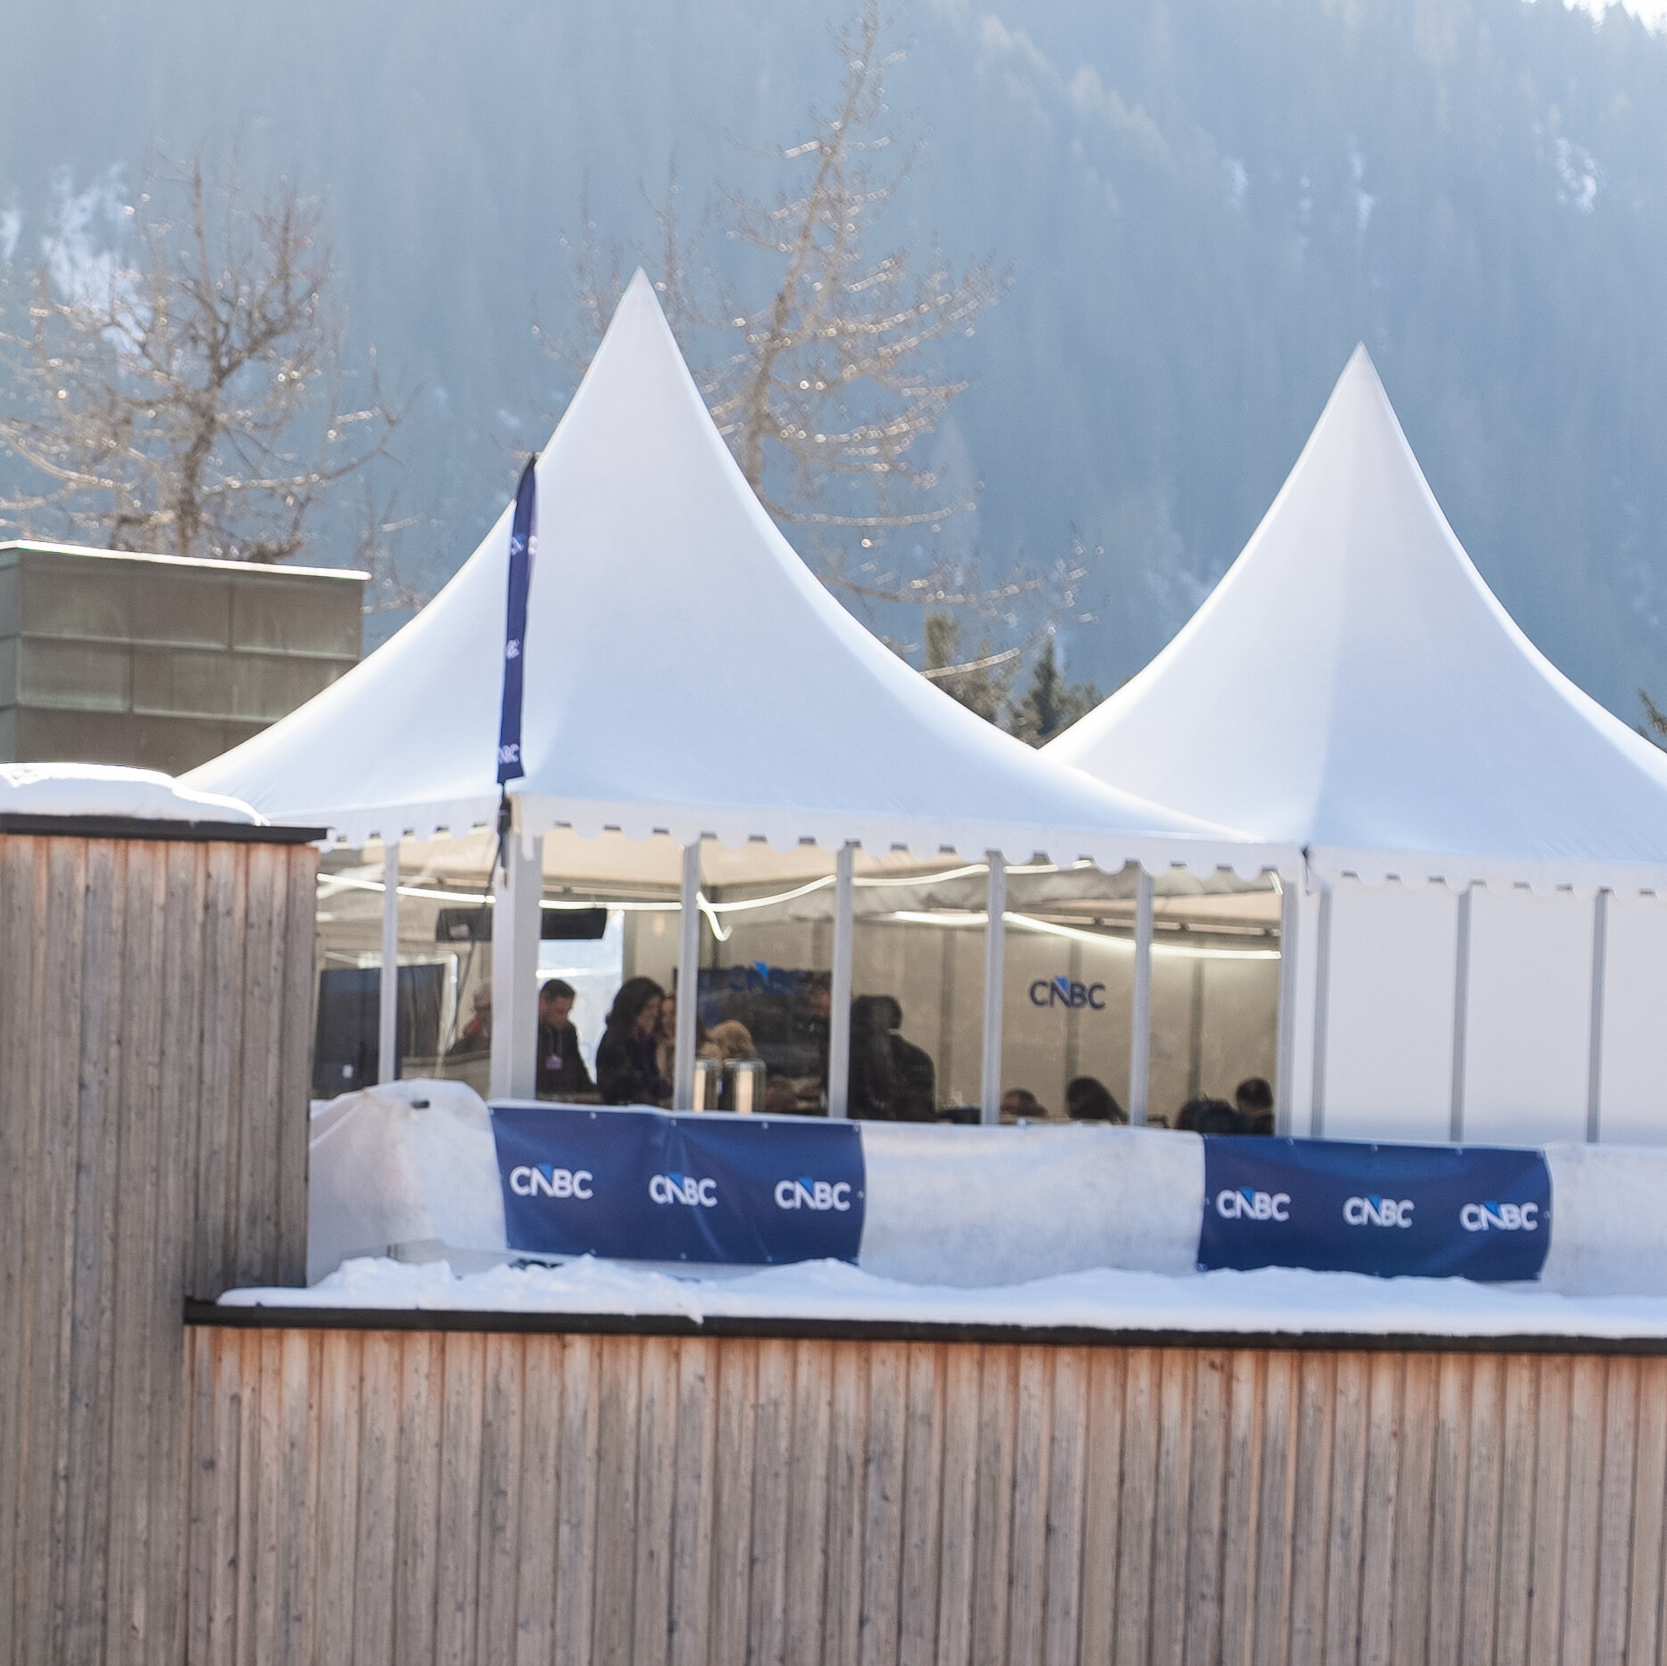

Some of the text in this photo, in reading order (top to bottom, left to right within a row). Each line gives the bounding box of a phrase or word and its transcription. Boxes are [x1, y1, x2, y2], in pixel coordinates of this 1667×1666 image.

[1029, 976, 1106, 1010] CNBC
[510, 1163, 593, 1199] CNBC
[649, 1172, 717, 1207] CNBC
[774, 1176, 852, 1211] CNBC
[1217, 1188, 1291, 1221] CNBC
[1343, 1194, 1414, 1228] CNBC
[1460, 1201, 1538, 1231] CNBC
